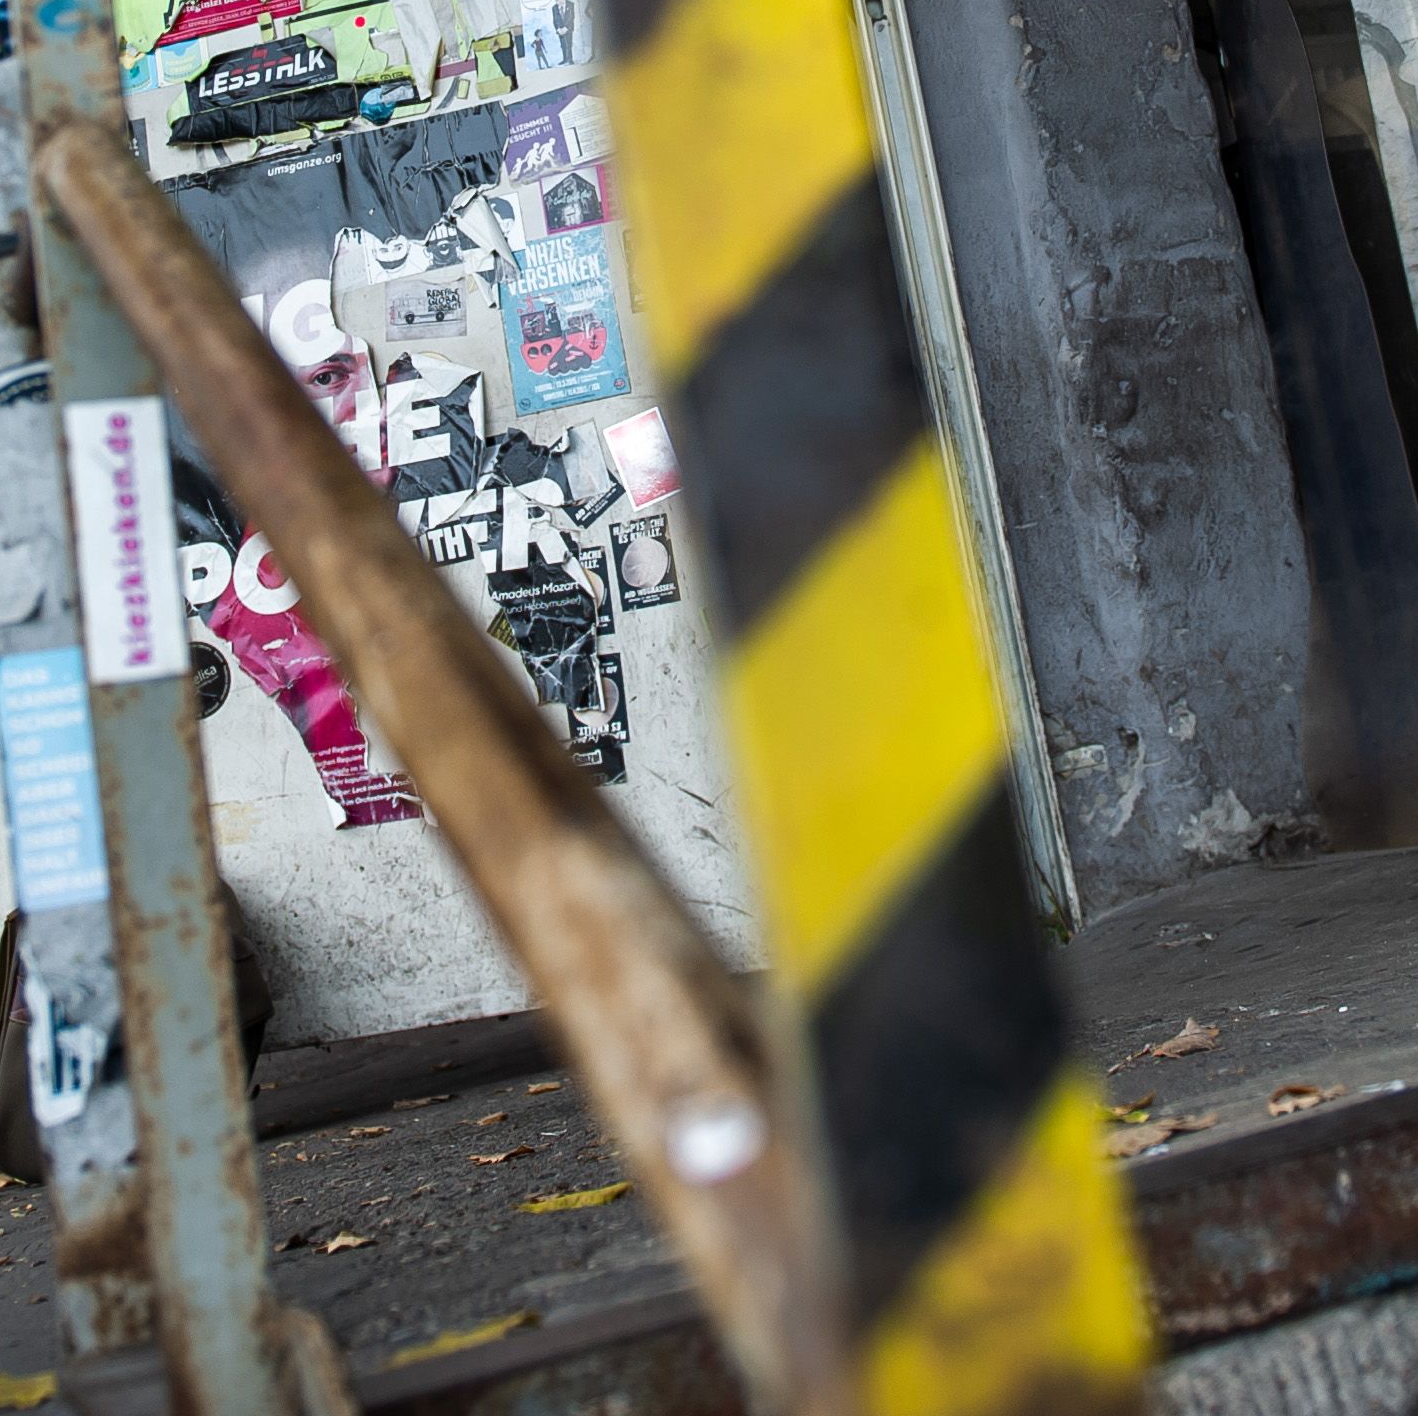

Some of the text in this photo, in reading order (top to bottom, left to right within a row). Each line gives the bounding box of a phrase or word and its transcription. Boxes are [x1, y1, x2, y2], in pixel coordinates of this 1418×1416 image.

[267, 151, 342, 178] umsganze.org
[525, 237, 574, 268] NAZIS
[507, 254, 602, 297] VERSENKEN
[491, 579, 581, 603] Amadeus Mozart
